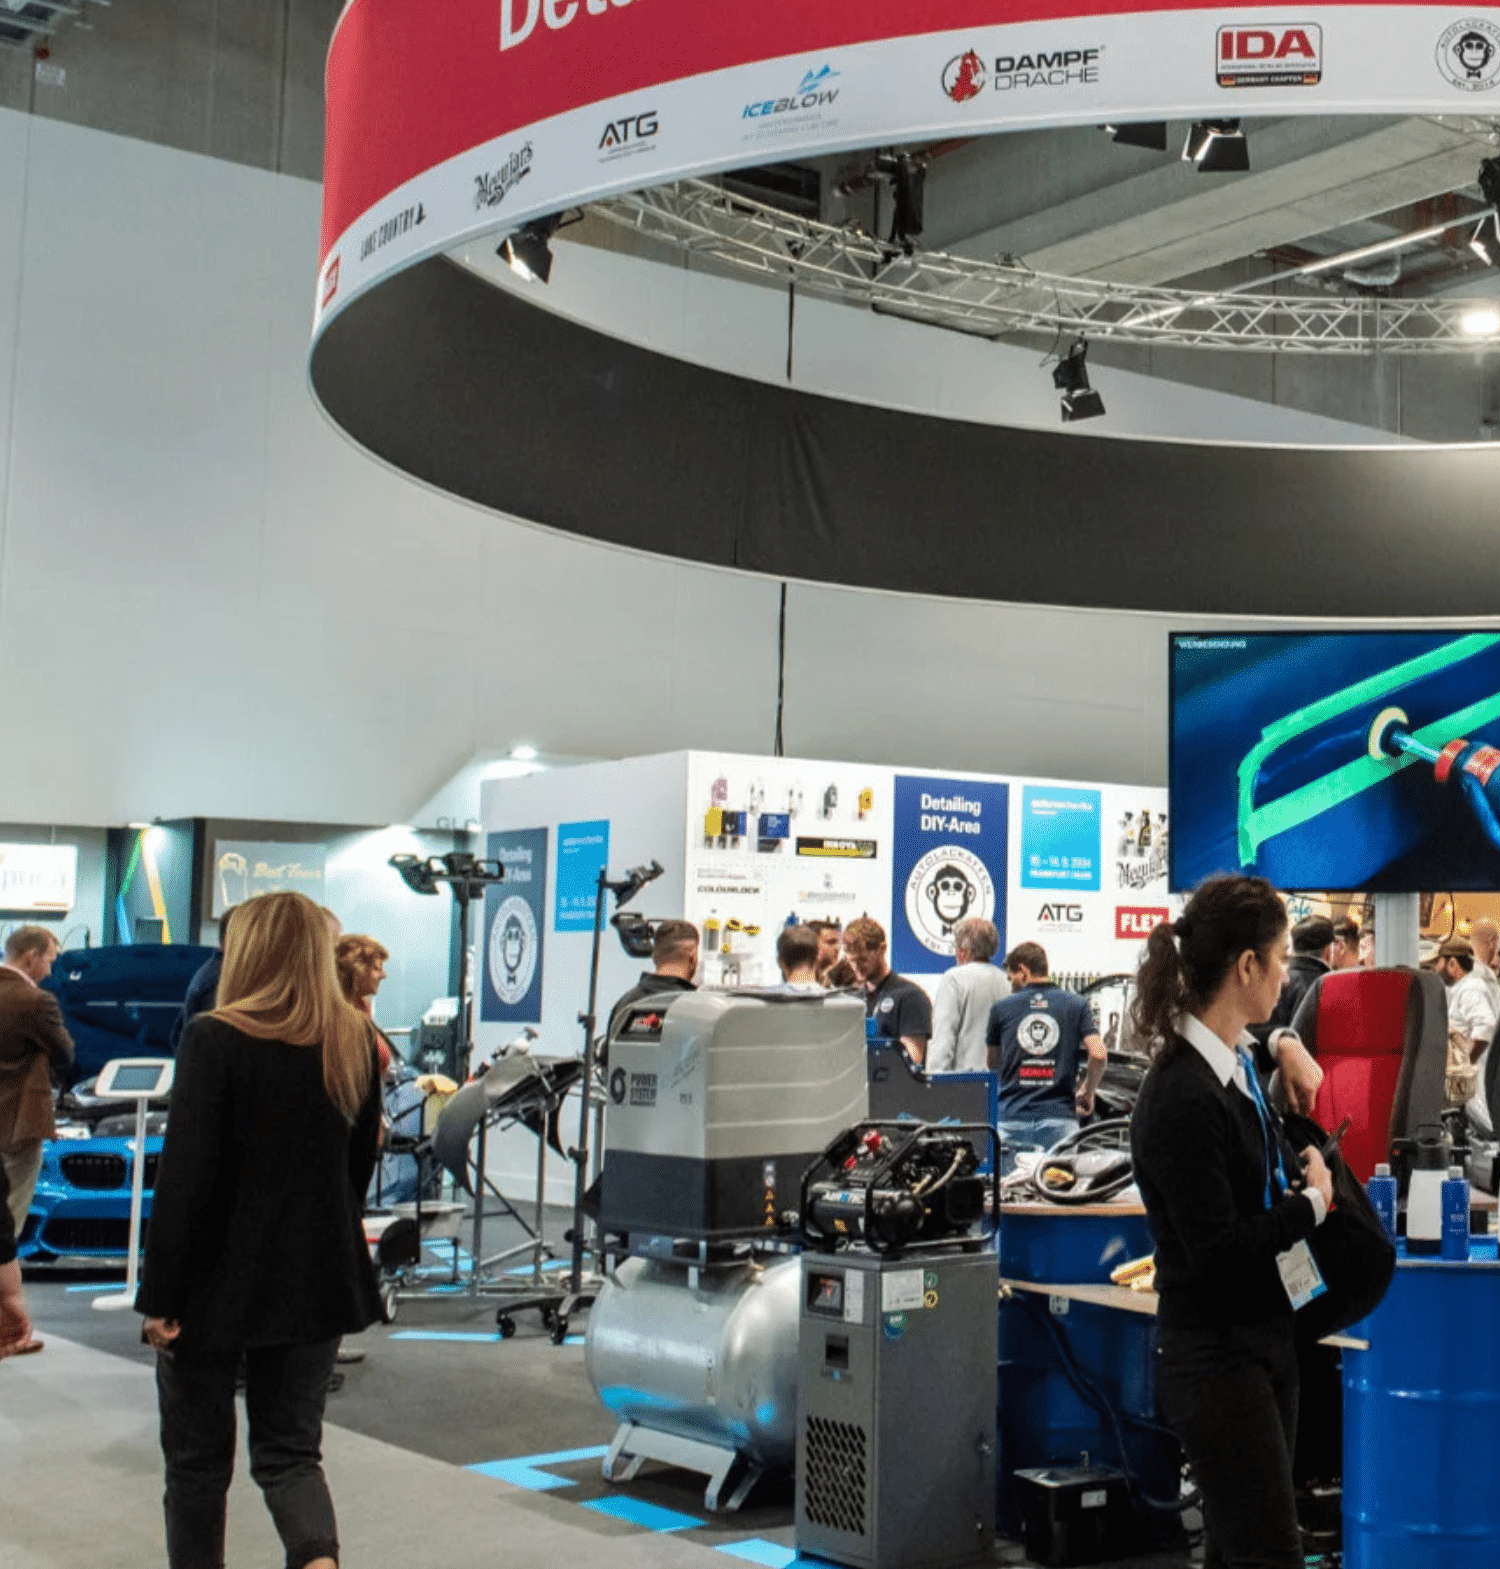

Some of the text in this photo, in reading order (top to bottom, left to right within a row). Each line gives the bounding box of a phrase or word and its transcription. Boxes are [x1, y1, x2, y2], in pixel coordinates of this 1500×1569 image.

[1221, 29, 1316, 60] IDA
[995, 48, 1100, 73] DAMPF
[994, 66, 1100, 91] DRACHE
[742, 87, 840, 119] ICEBLOW
[598, 110, 659, 150] ATG
[920, 793, 981, 818] Detailing
[920, 813, 981, 835] DIY-Area
[1037, 903, 1084, 922] ATG
